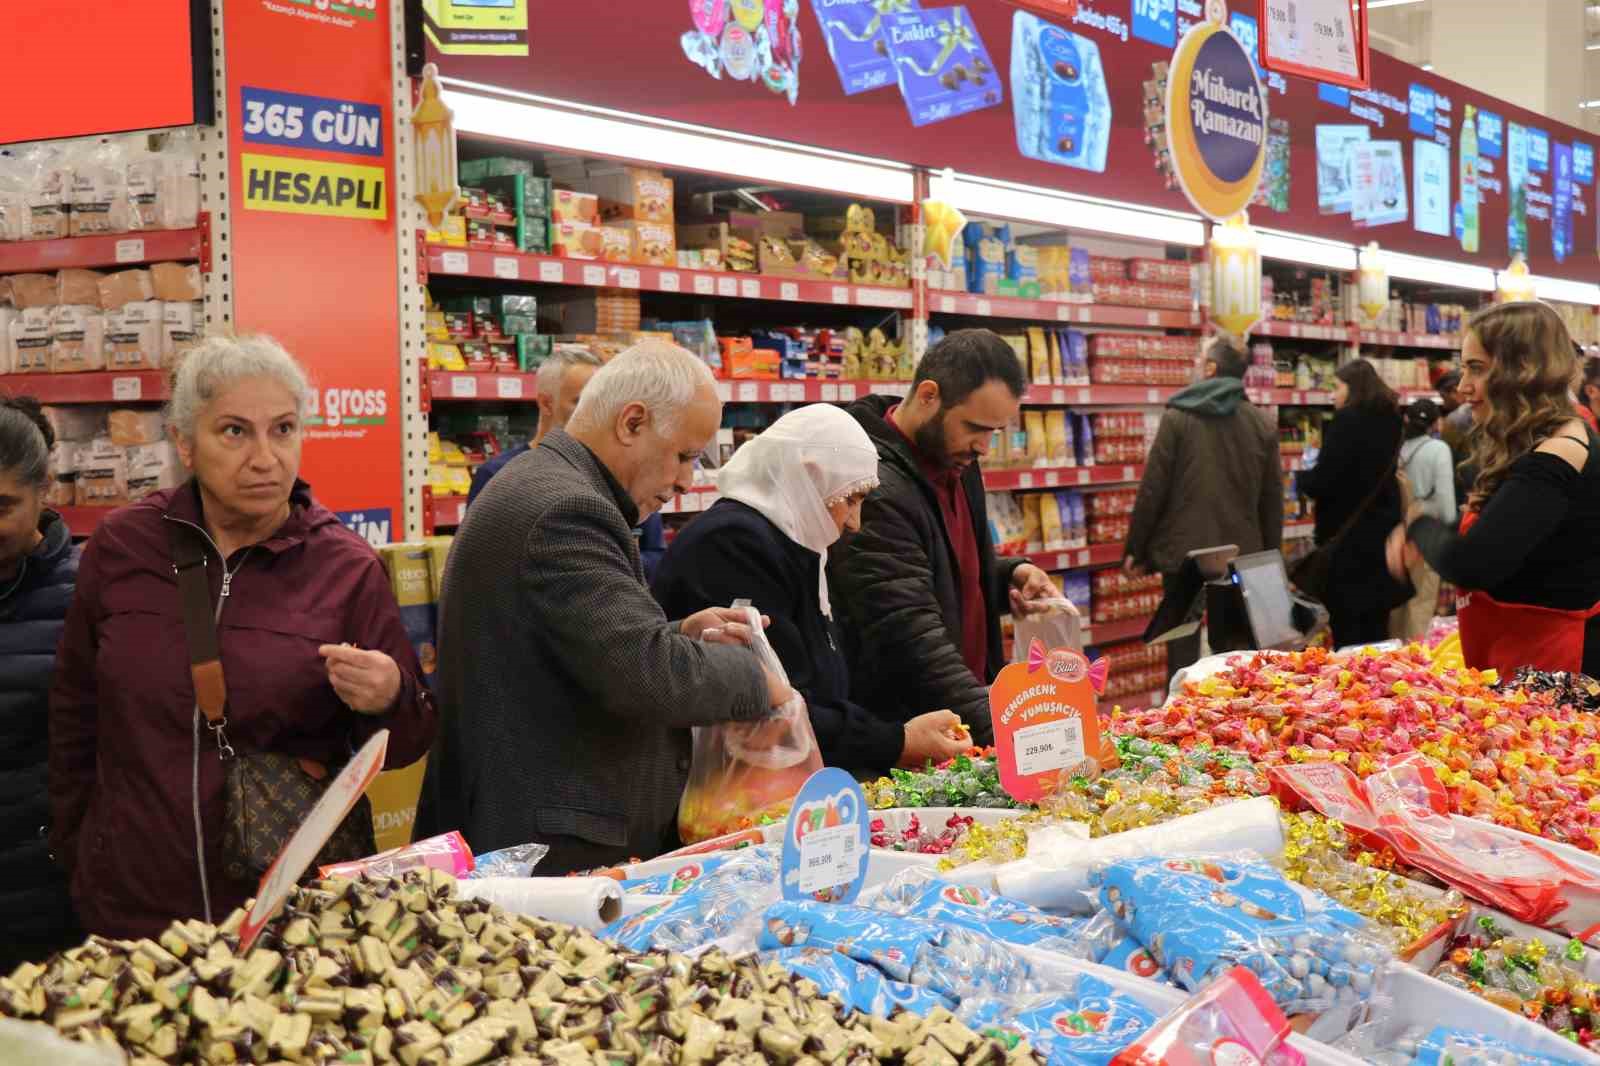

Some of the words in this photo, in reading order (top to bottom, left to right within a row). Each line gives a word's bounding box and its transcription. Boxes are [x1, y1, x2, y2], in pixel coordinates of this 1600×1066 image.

[1192, 68, 1261, 121] Mübarek
[244, 100, 304, 139] 365
[311, 104, 379, 148] GÜN
[1191, 98, 1262, 146] Ramazan
[247, 168, 382, 210] HESAPLI
[325, 387, 387, 426] gross
[1000, 684, 1057, 725] RENGARENK
